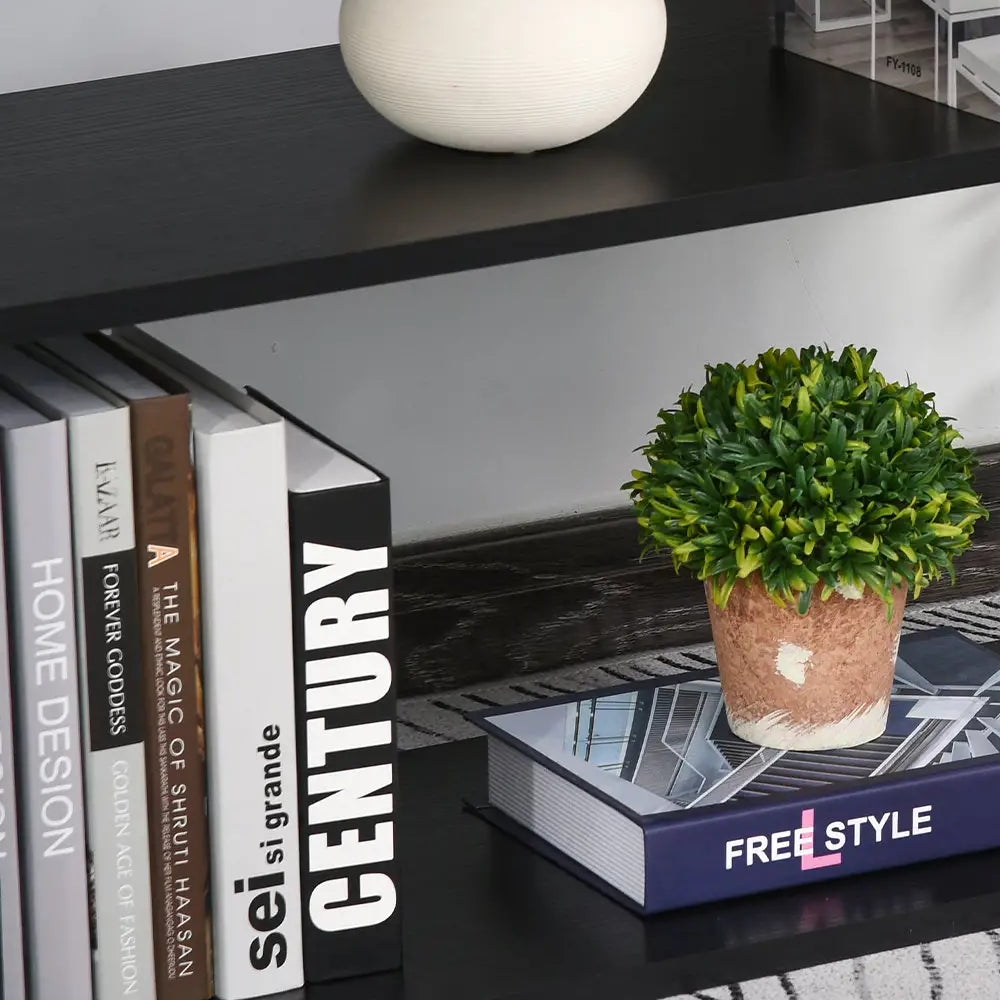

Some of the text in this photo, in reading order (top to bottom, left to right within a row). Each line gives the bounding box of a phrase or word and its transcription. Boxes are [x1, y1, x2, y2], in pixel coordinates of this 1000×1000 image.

[886, 55, 922, 78] FY-1108
[30, 557, 68, 686] HOME
[102, 563, 127, 737] FOREVER GODDESS
[162, 581, 195, 978] THE MAGIC OF SHRUTI HAASAN
[302, 541, 397, 933] CENTURY
[725, 826, 814, 870] FREE
[824, 805, 933, 852] STYLE
[110, 759, 138, 996] GOLDEN AGE OF FASHION
[234, 723, 289, 971] sei si grande
